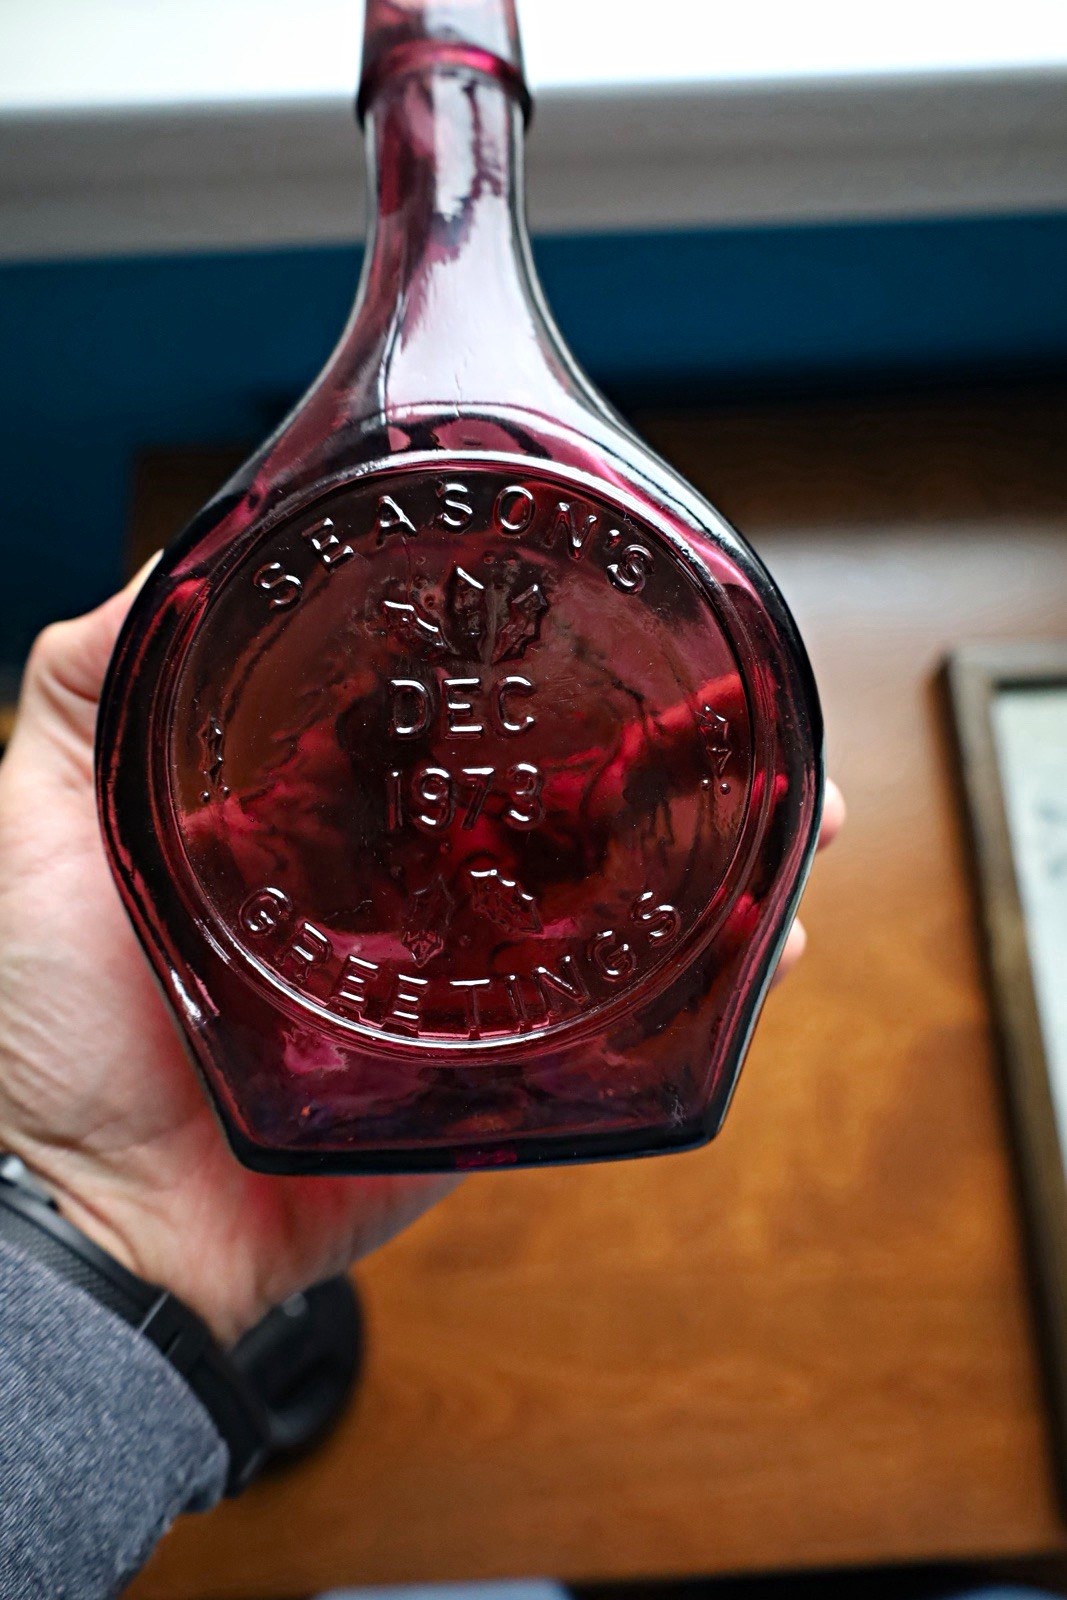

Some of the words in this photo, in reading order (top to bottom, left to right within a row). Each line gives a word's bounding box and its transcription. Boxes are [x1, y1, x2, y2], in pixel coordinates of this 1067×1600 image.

[253, 482, 656, 611] SEASON'S
[389, 675, 537, 740] DEC
[387, 762, 546, 832] 1973
[238, 886, 683, 1038] GREETINGS
